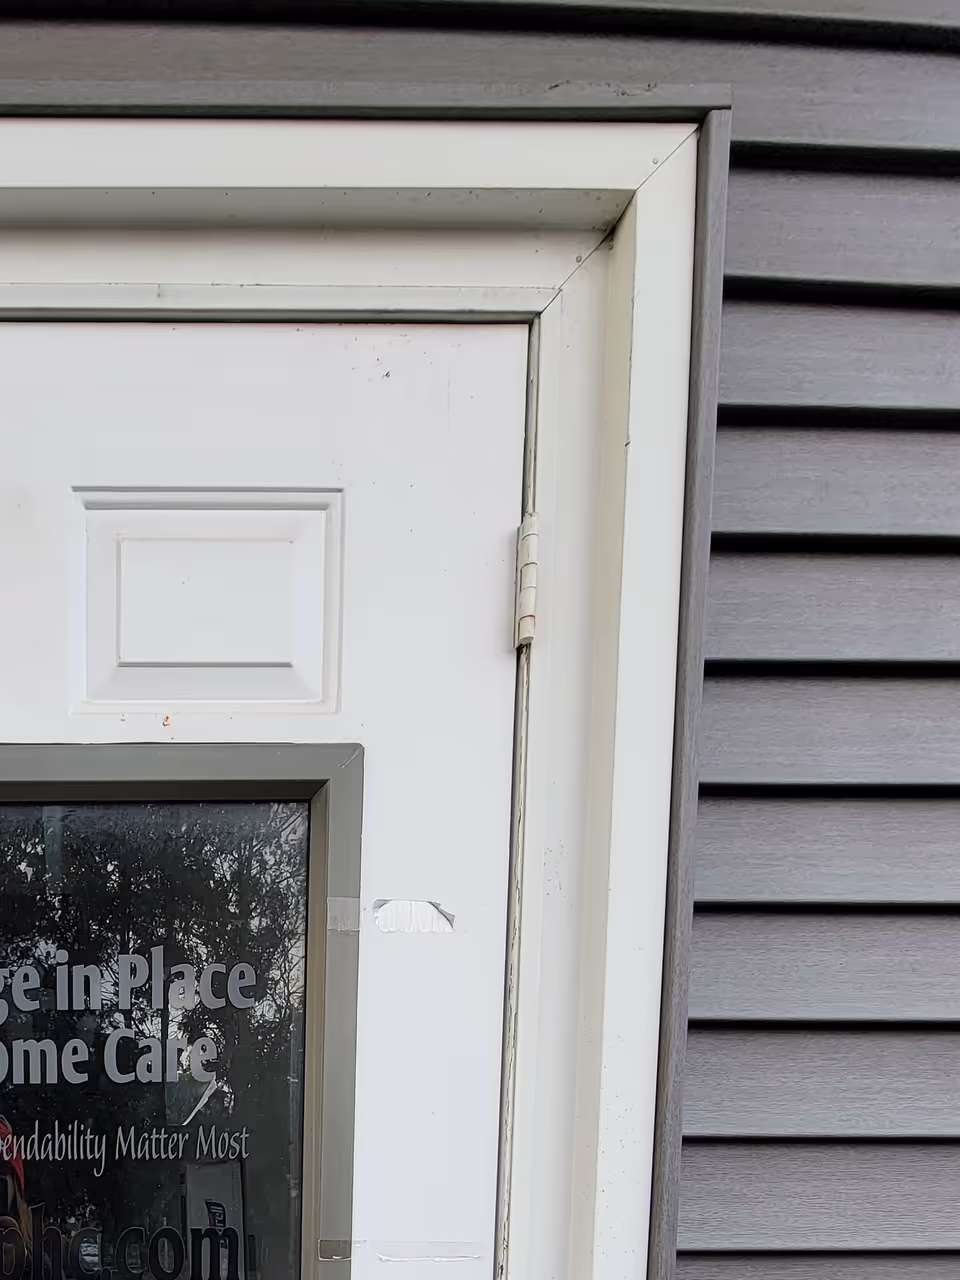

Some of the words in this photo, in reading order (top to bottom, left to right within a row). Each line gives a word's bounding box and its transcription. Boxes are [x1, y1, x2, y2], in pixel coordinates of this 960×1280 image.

[56, 949, 101, 1011] in
[117, 945, 257, 1011] Place
[104, 1028, 218, 1085] Care
[114, 1124, 190, 1163] Matter
[195, 1125, 251, 1160] Most
